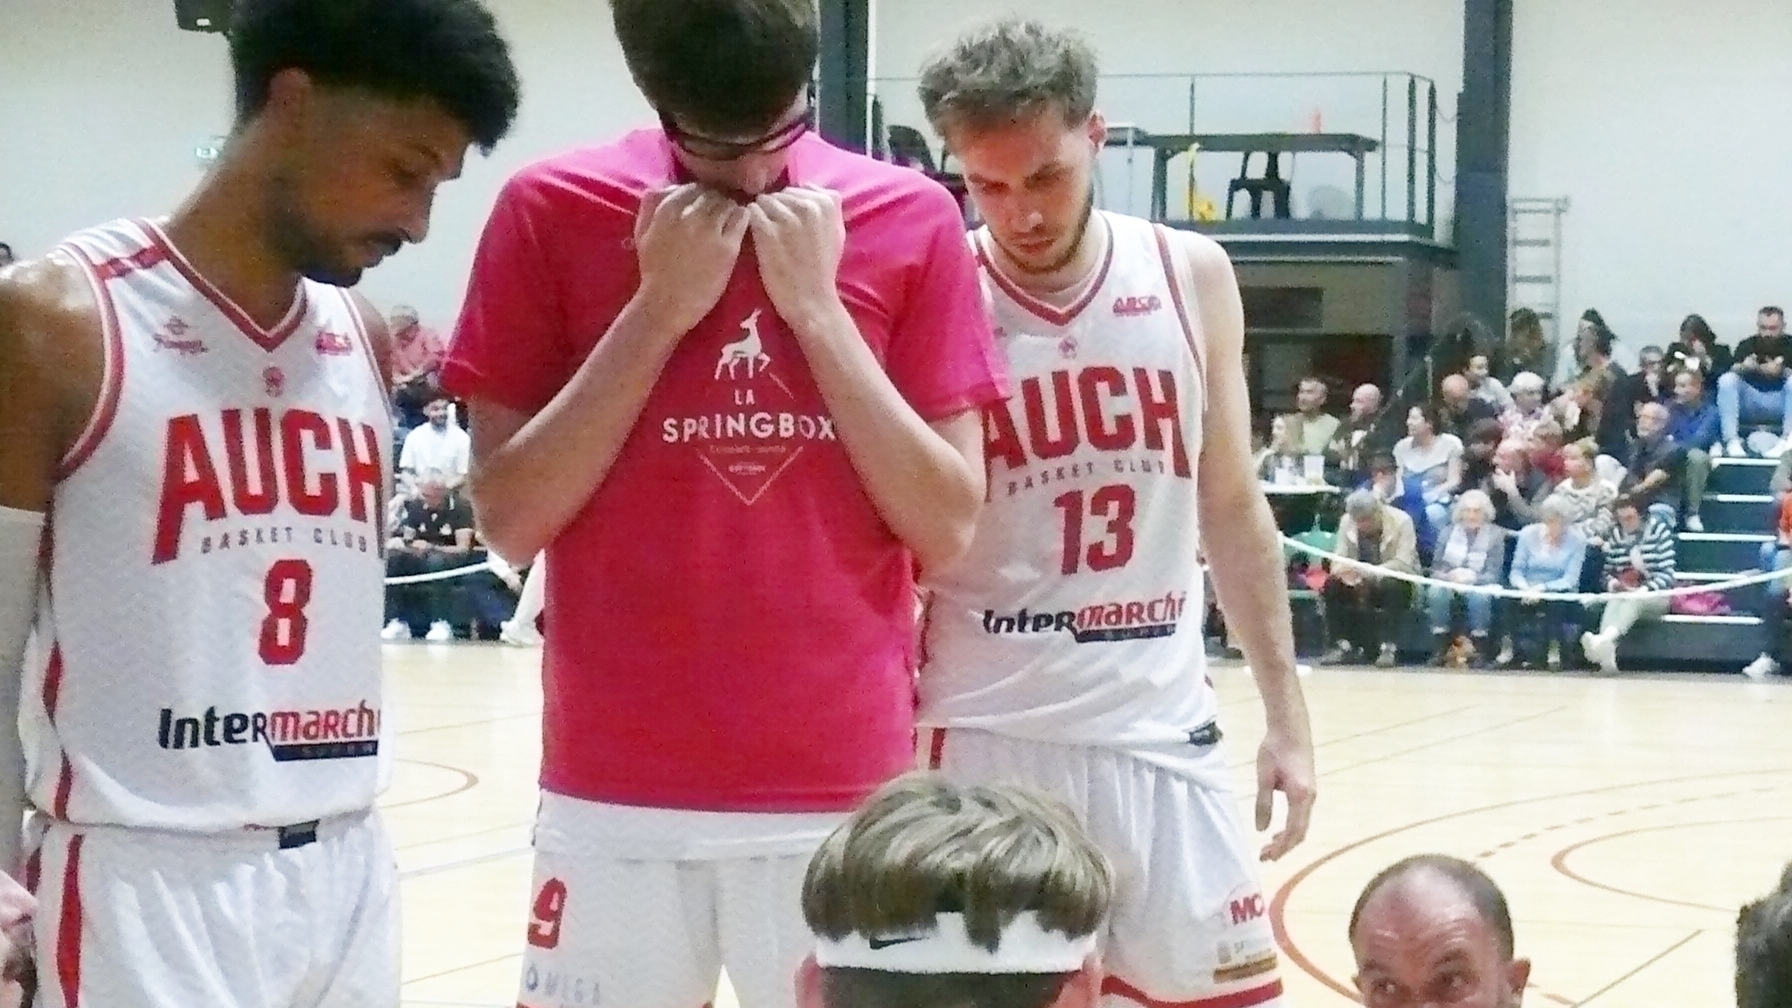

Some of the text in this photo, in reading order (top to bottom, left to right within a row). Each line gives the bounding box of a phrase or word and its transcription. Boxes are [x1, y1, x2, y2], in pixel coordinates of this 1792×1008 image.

[662, 412, 836, 443] SPRINGBOX
[734, 389, 755, 405] LA
[984, 366, 1192, 502] AUCH
[152, 407, 384, 565] AUCH
[1007, 462, 1094, 496] BASKET
[201, 527, 366, 553] BASKET CLUB
[1054, 484, 1135, 575] 13
[259, 559, 312, 665] 8
[158, 698, 381, 750] Intermarch
[527, 877, 568, 950] 9
